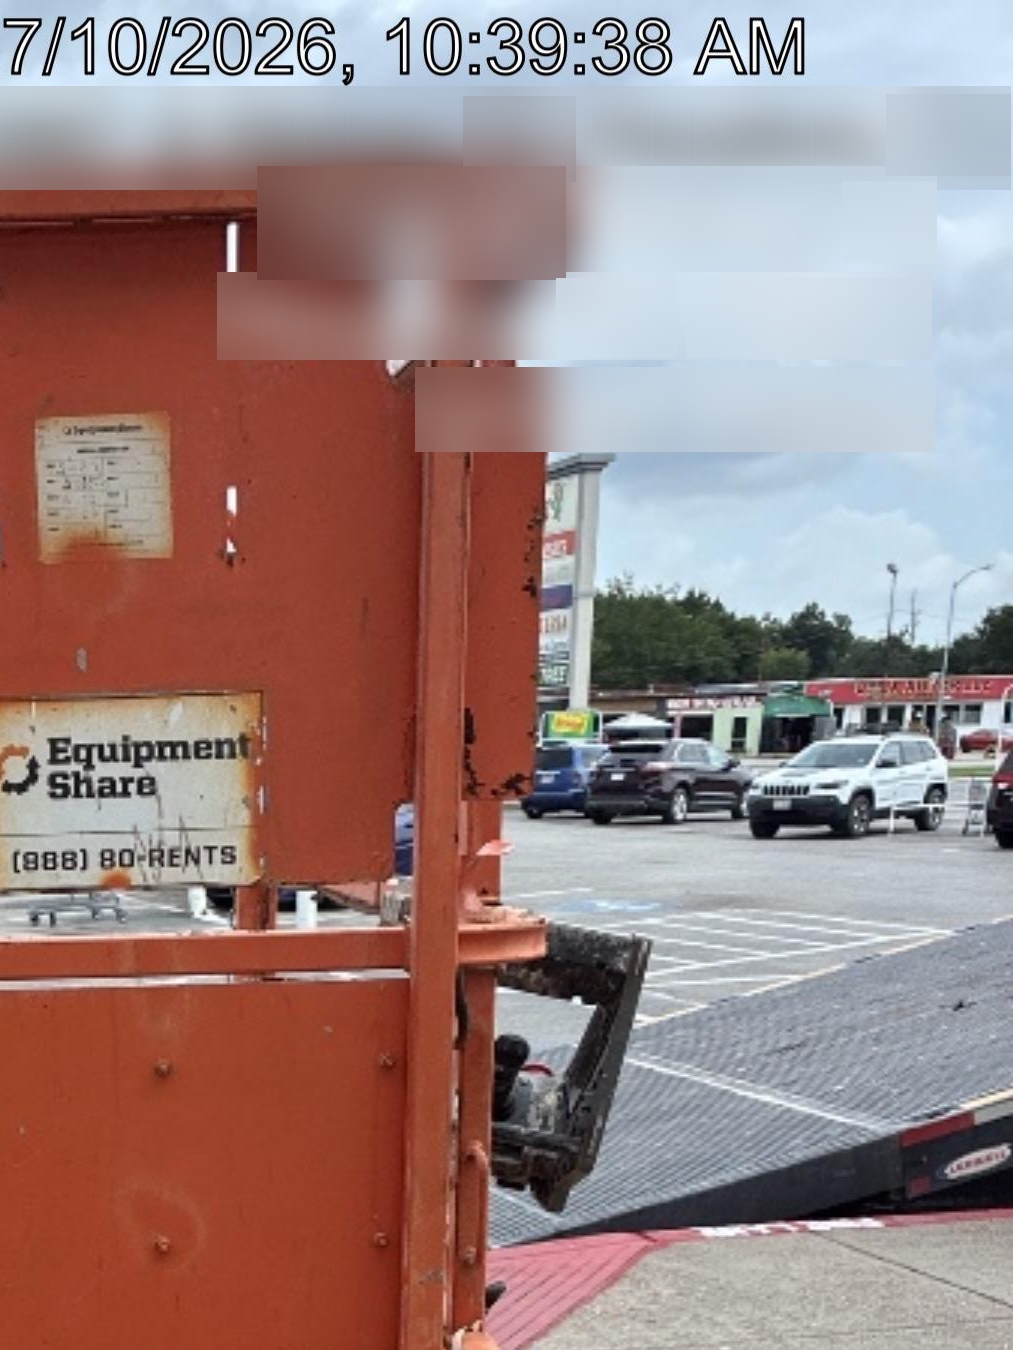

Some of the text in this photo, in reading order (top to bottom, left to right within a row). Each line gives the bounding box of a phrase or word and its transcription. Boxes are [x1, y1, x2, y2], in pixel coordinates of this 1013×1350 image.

[46, 731, 253, 768] Equipment
[48, 769, 157, 799] Share
[99, 844, 238, 869] 80-RENTS
